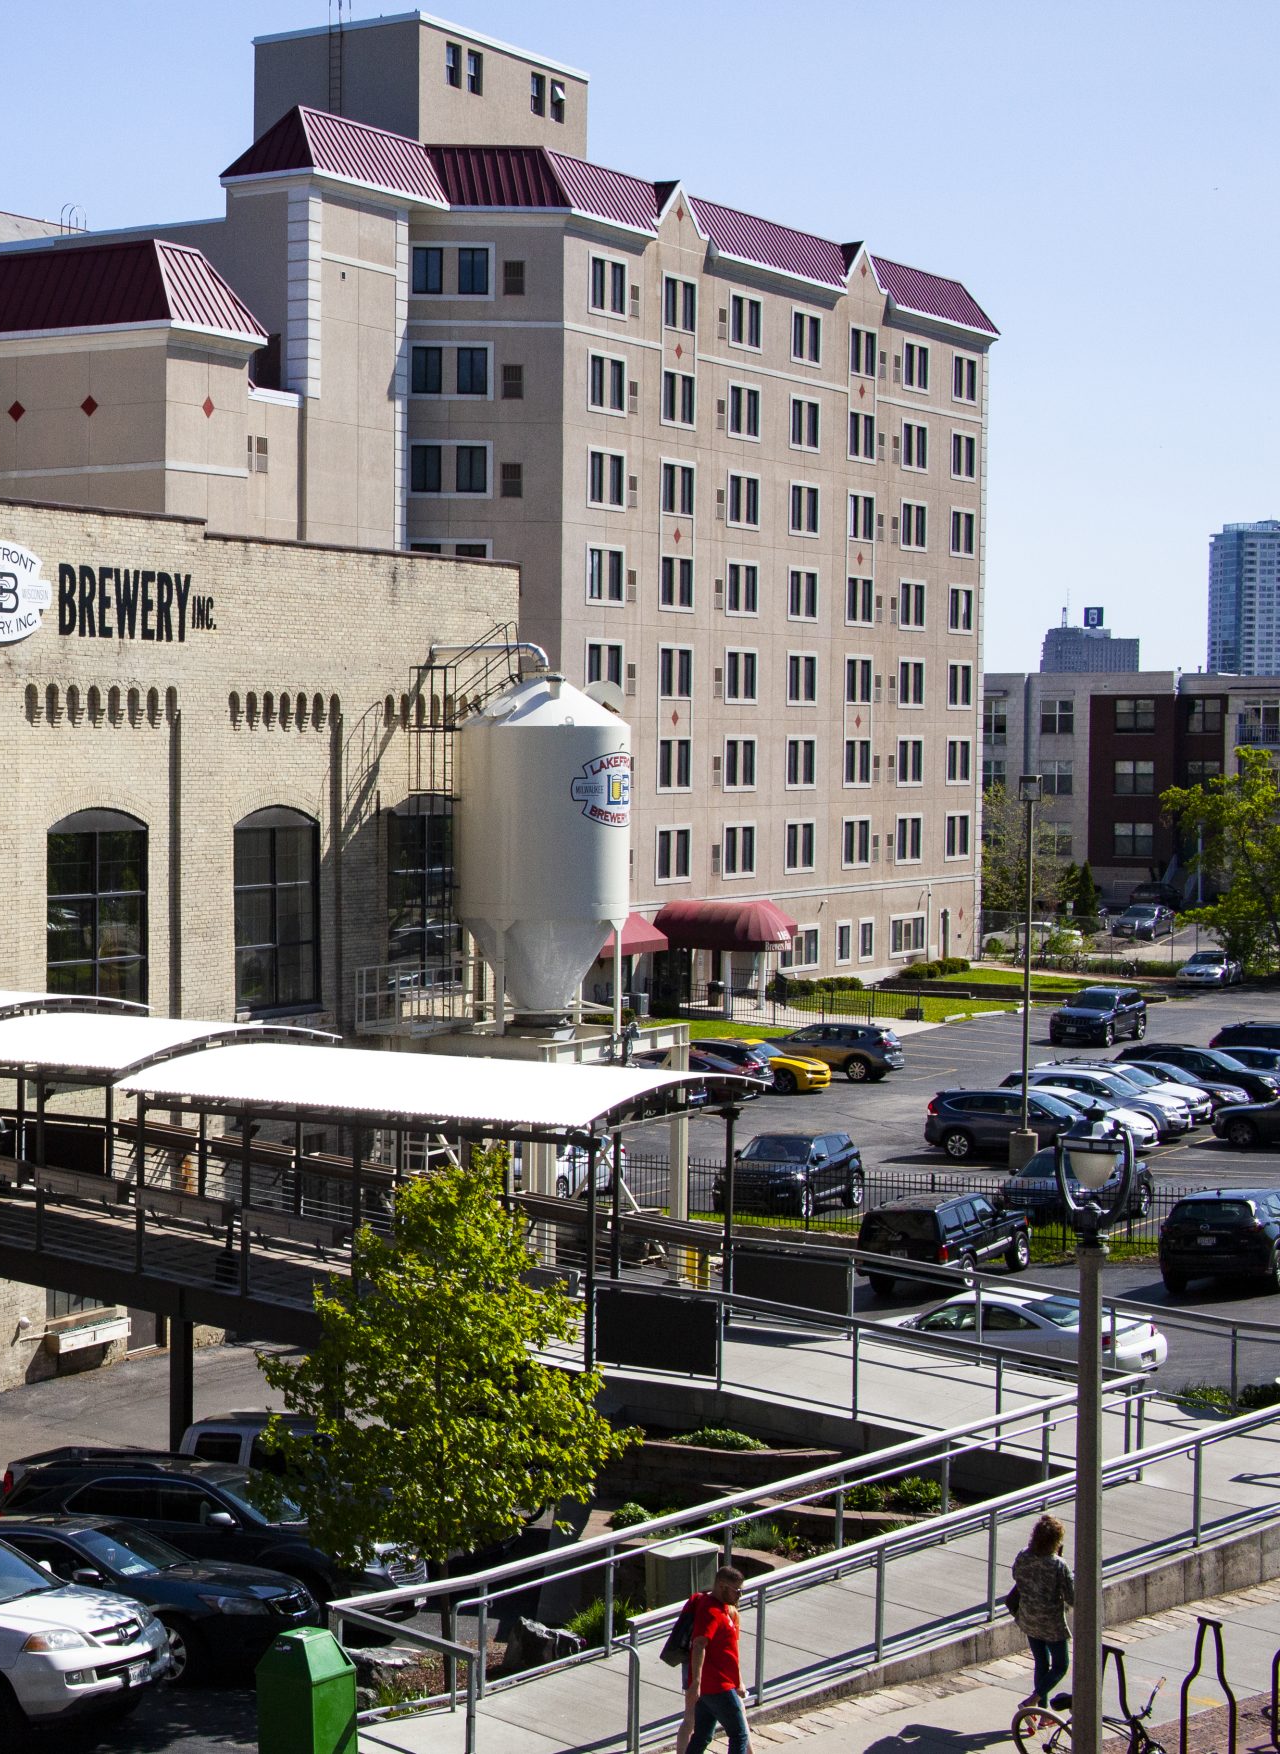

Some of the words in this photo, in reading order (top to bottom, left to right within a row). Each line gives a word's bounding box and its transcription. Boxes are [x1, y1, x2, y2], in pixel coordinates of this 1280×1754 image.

[22, 588, 48, 600] WISCONSIN
[58, 563, 192, 643] BREWERY
[192, 595, 217, 630] INC.
[16, 613, 37, 632] INC.
[576, 785, 604, 794] MILWAUKEE
